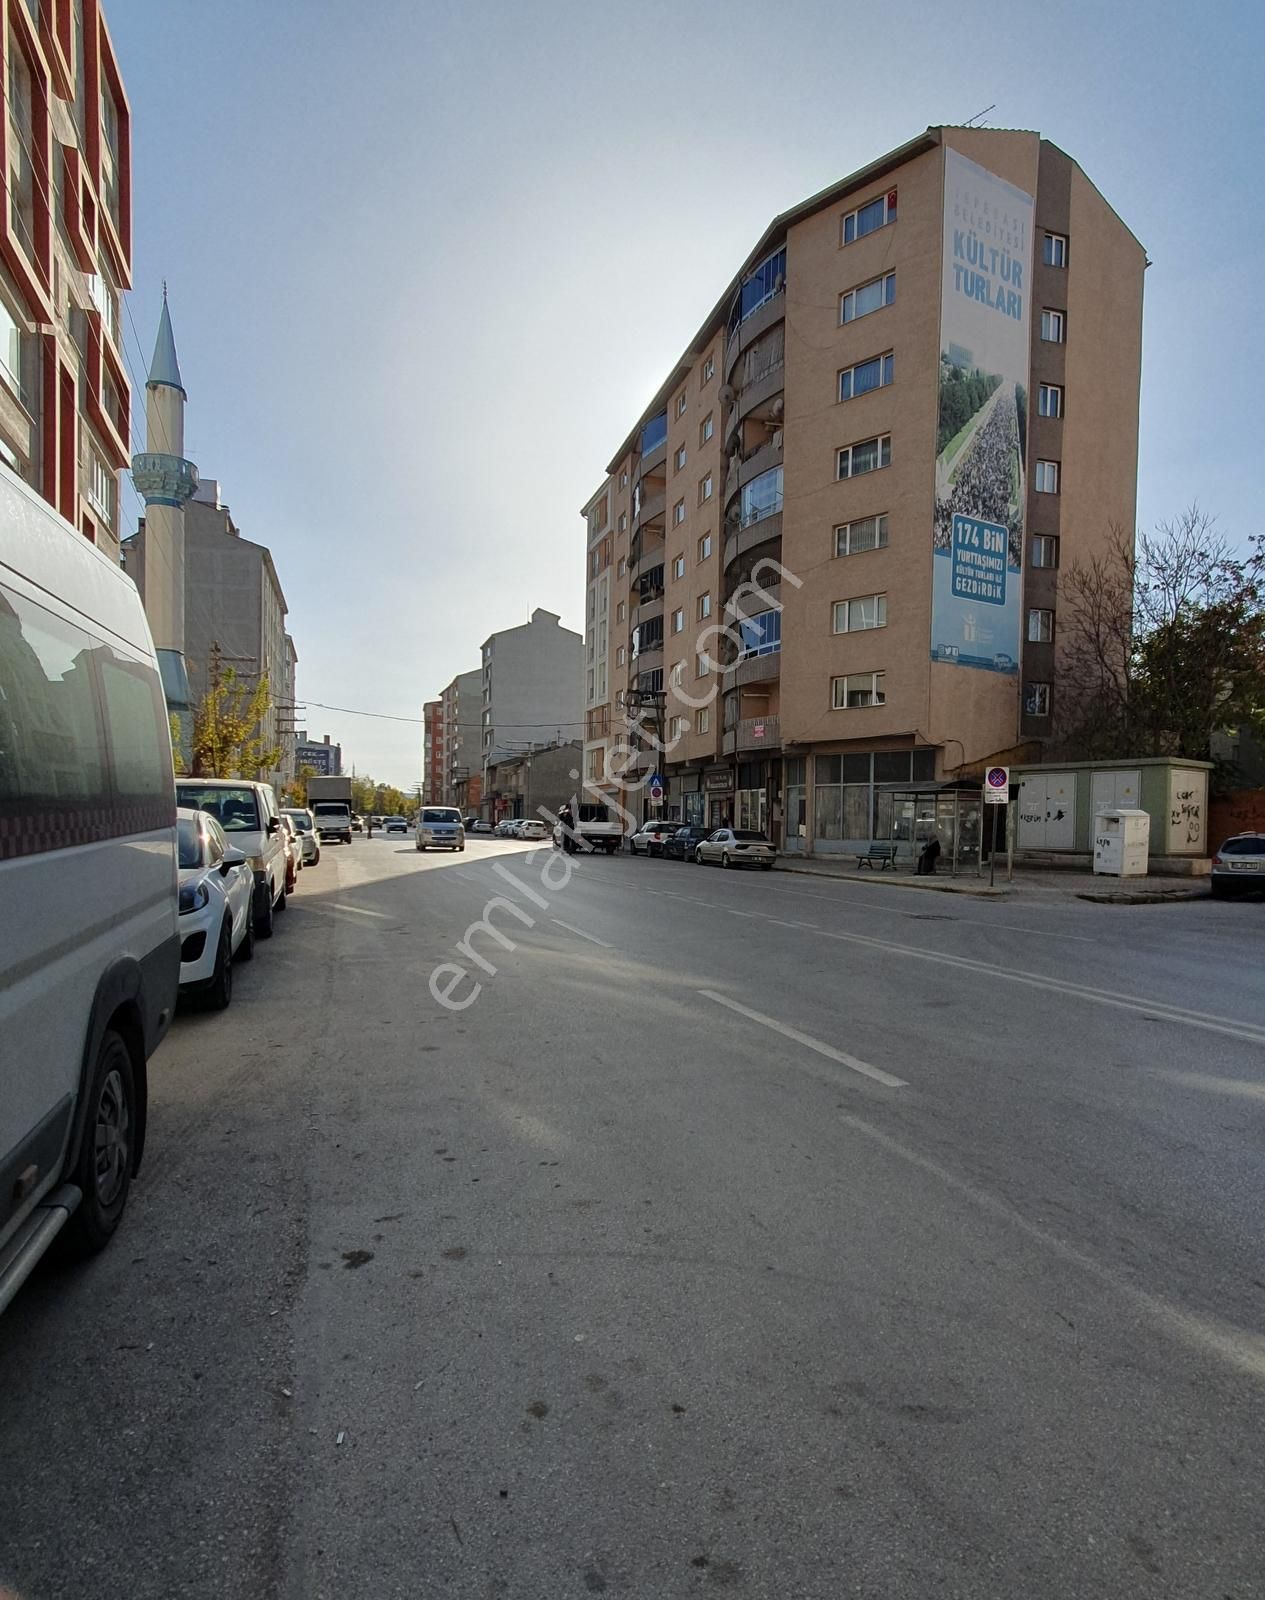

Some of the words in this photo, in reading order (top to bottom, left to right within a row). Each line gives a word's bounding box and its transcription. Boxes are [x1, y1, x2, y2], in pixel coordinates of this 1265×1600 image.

[953, 229, 1023, 289] KÜLTÜR
[952, 262, 1022, 321] TURLARI
[957, 521, 979, 547] 174
[956, 548, 1003, 571] YURTTAŞIMIZI
